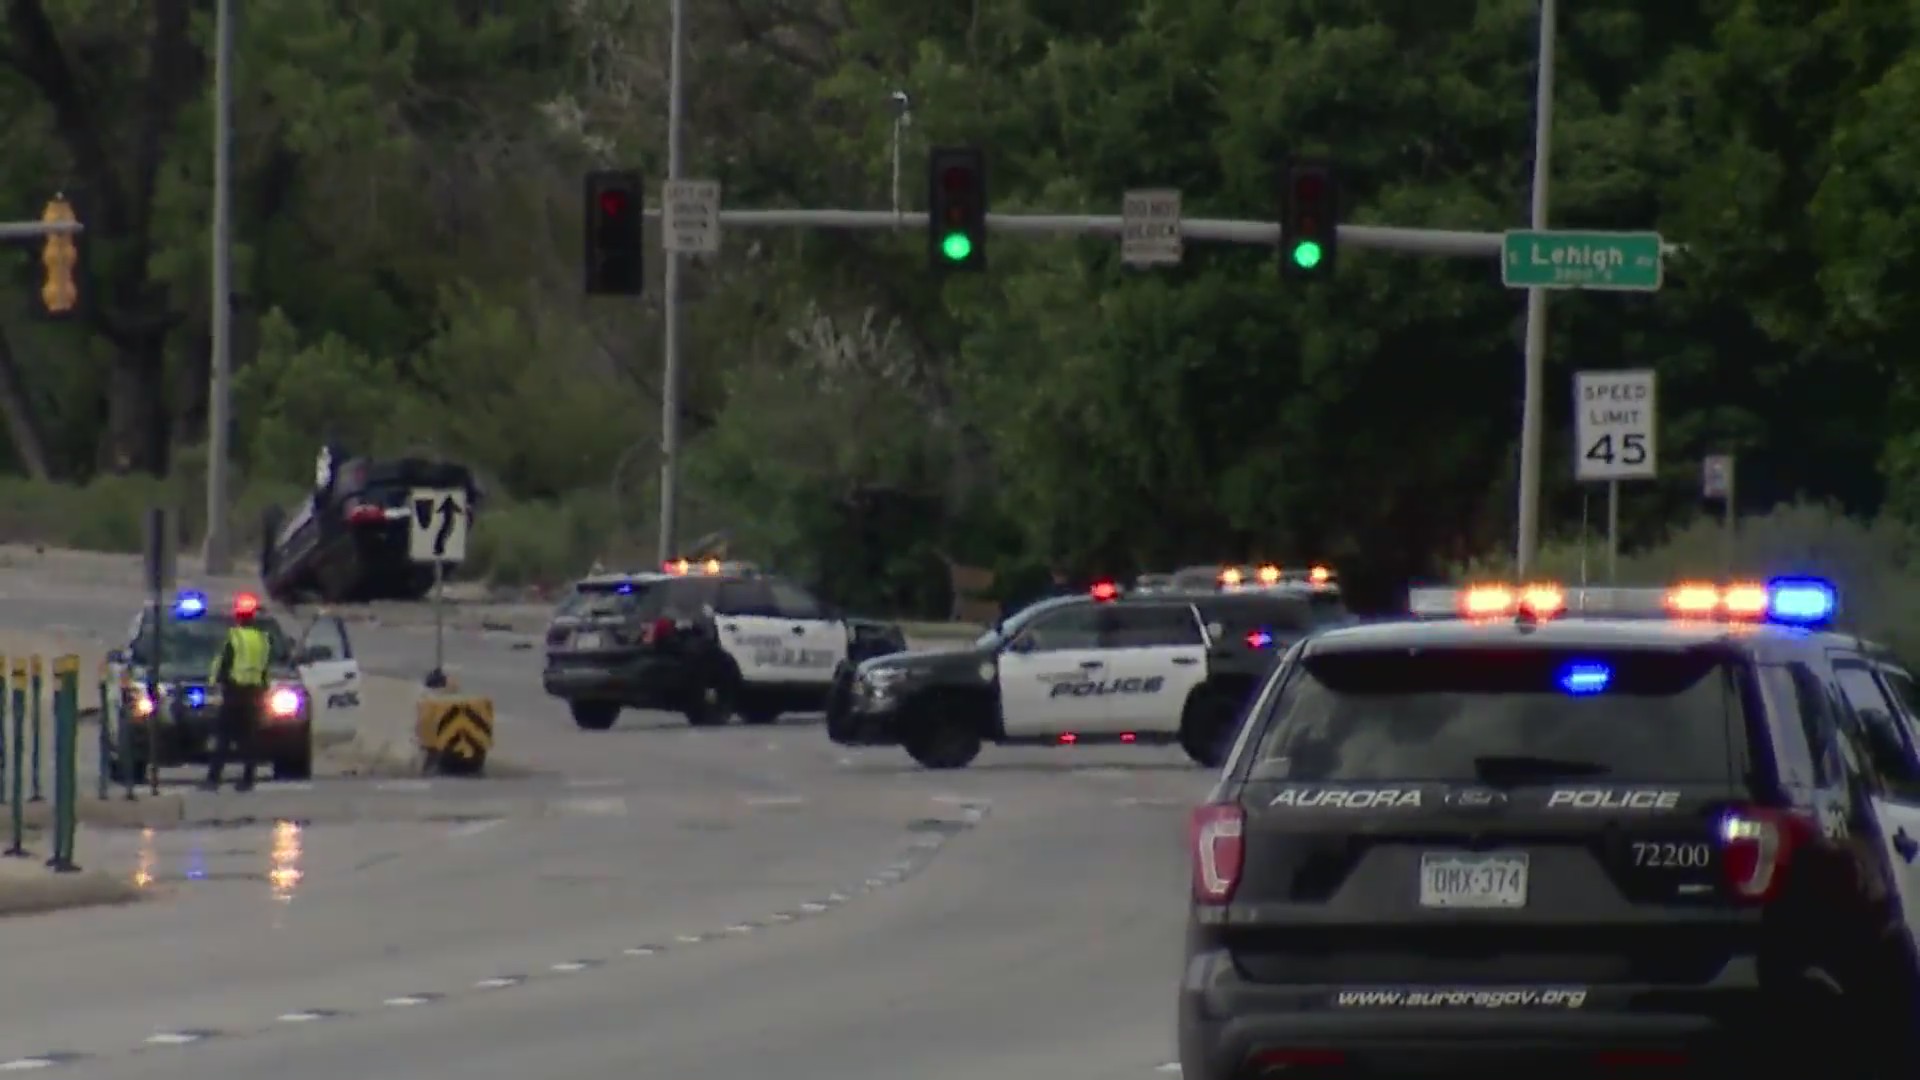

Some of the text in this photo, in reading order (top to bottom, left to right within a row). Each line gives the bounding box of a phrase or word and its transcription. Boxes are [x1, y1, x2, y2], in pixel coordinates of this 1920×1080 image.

[1530, 242, 1624, 270] Lehigh
[1583, 383, 1647, 401] SPEED
[1590, 409, 1641, 426] LIMIT
[1585, 433, 1647, 465] 45
[1050, 675, 1165, 699] POLICE
[1269, 788, 1681, 809] AURORA POLICE
[1631, 842, 1710, 867] 72200
[1337, 989, 1588, 1009] www.auroragov.org
